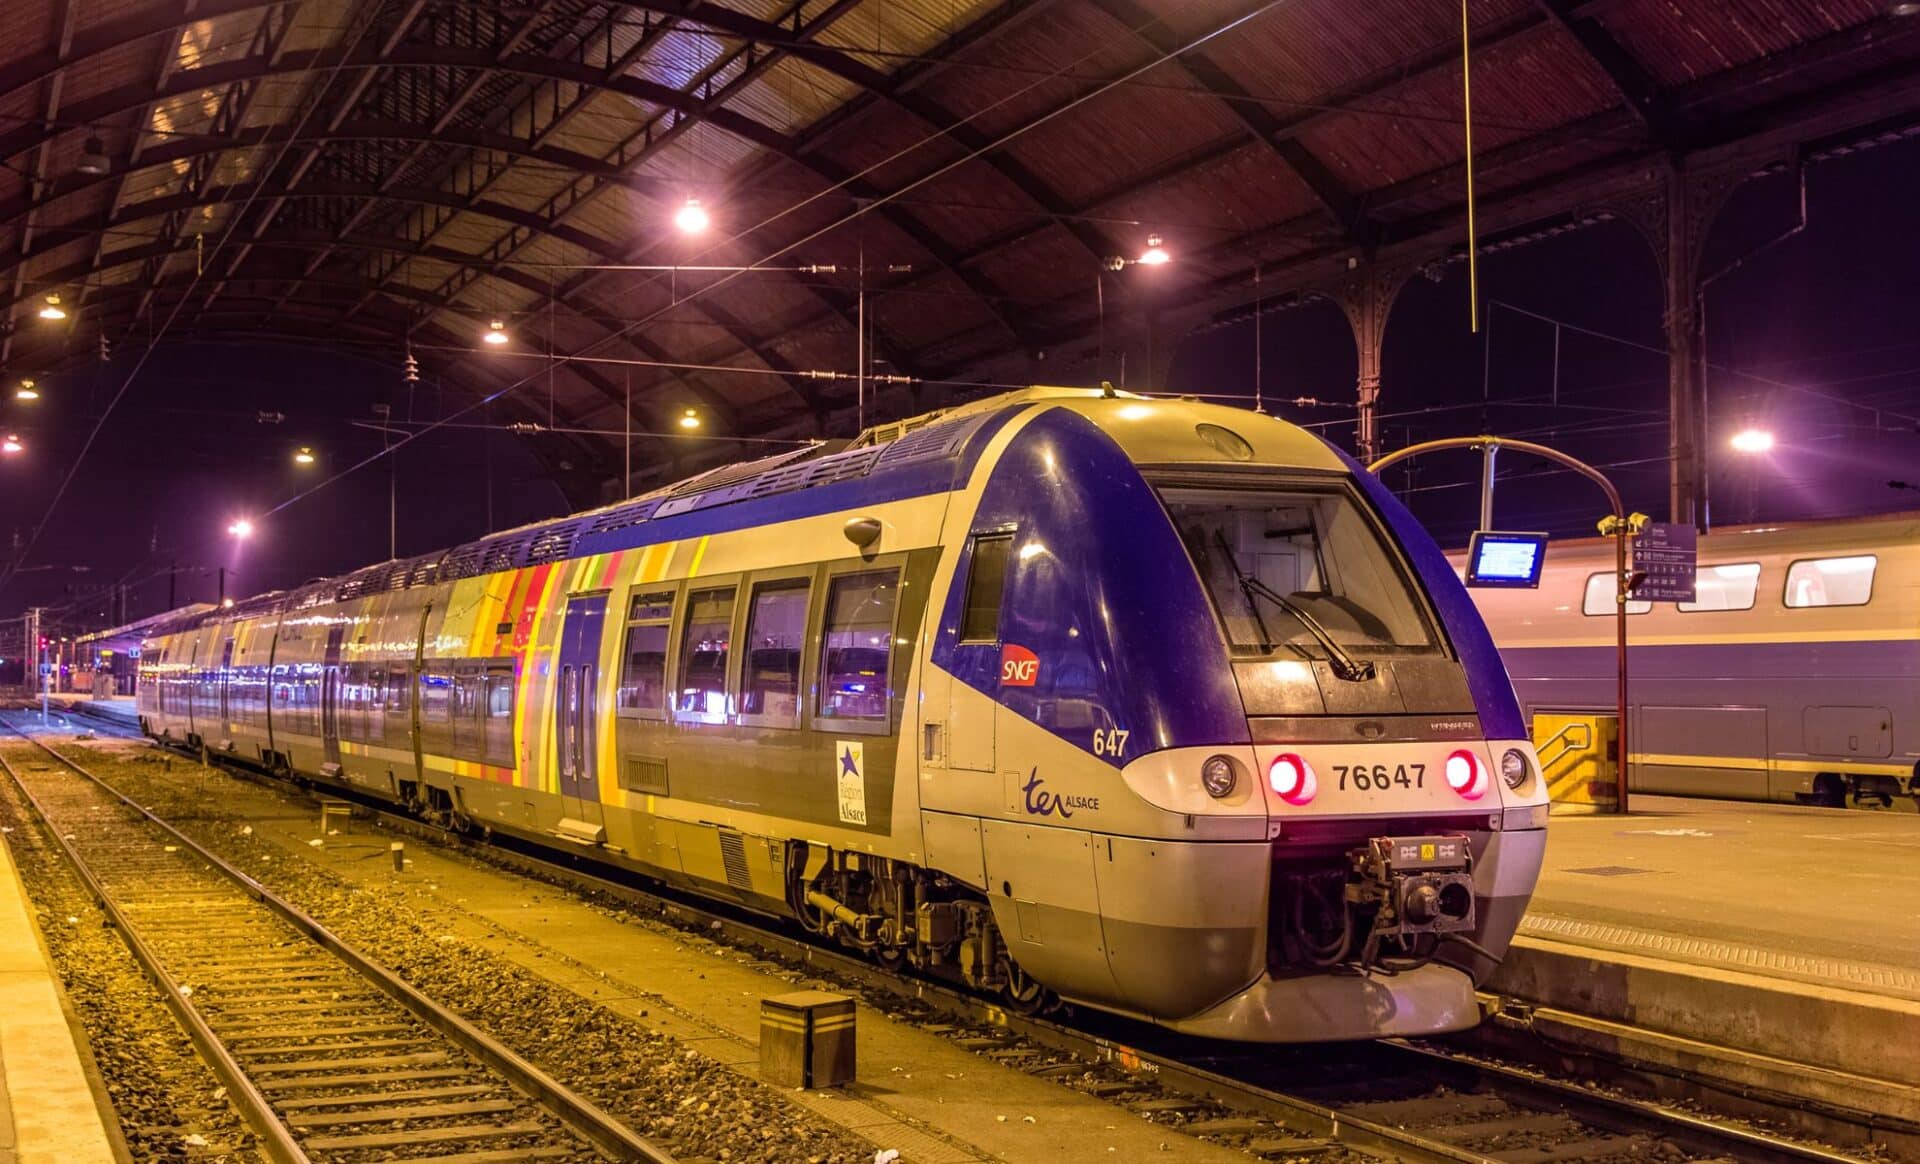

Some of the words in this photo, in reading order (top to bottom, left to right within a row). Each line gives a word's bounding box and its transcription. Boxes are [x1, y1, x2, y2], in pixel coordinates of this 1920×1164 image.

[1002, 660, 1038, 680] SNCF
[1093, 728, 1129, 756] 647
[1332, 764, 1425, 790] 76647
[1022, 766, 1072, 819] ter
[1066, 796, 1100, 810] ALSACE
[841, 802, 865, 822] Alsace
